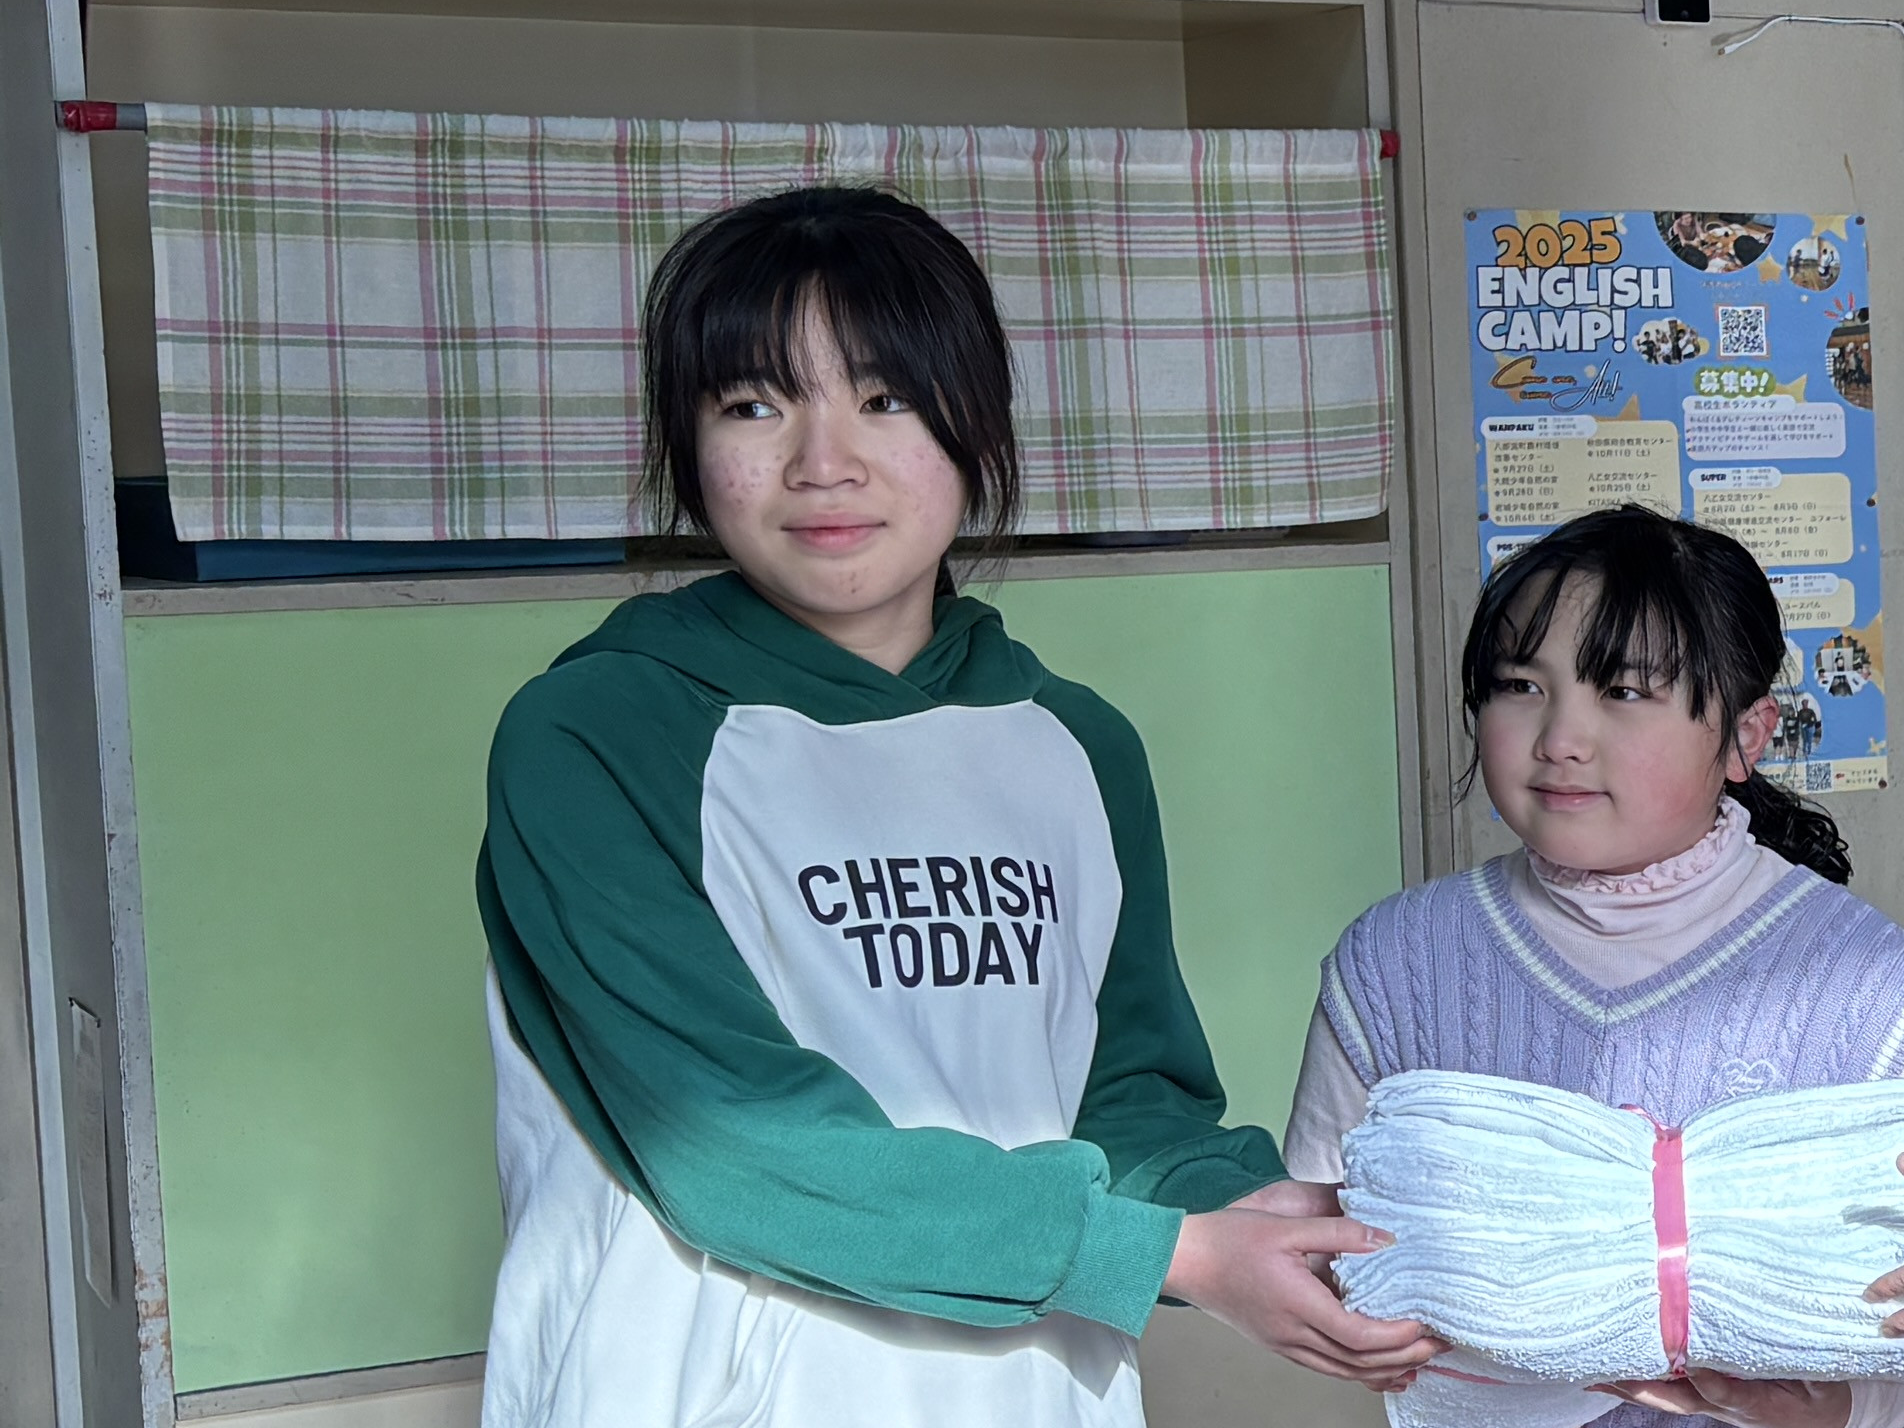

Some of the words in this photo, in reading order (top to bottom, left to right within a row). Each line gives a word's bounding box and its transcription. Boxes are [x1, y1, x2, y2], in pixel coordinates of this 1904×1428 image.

[1492, 217, 1623, 268] 2025
[1477, 264, 1674, 308] ENGLISH
[1477, 307, 1629, 353] CAMP!
[798, 856, 1059, 926] CHERISH
[842, 921, 1043, 988] TODAY
